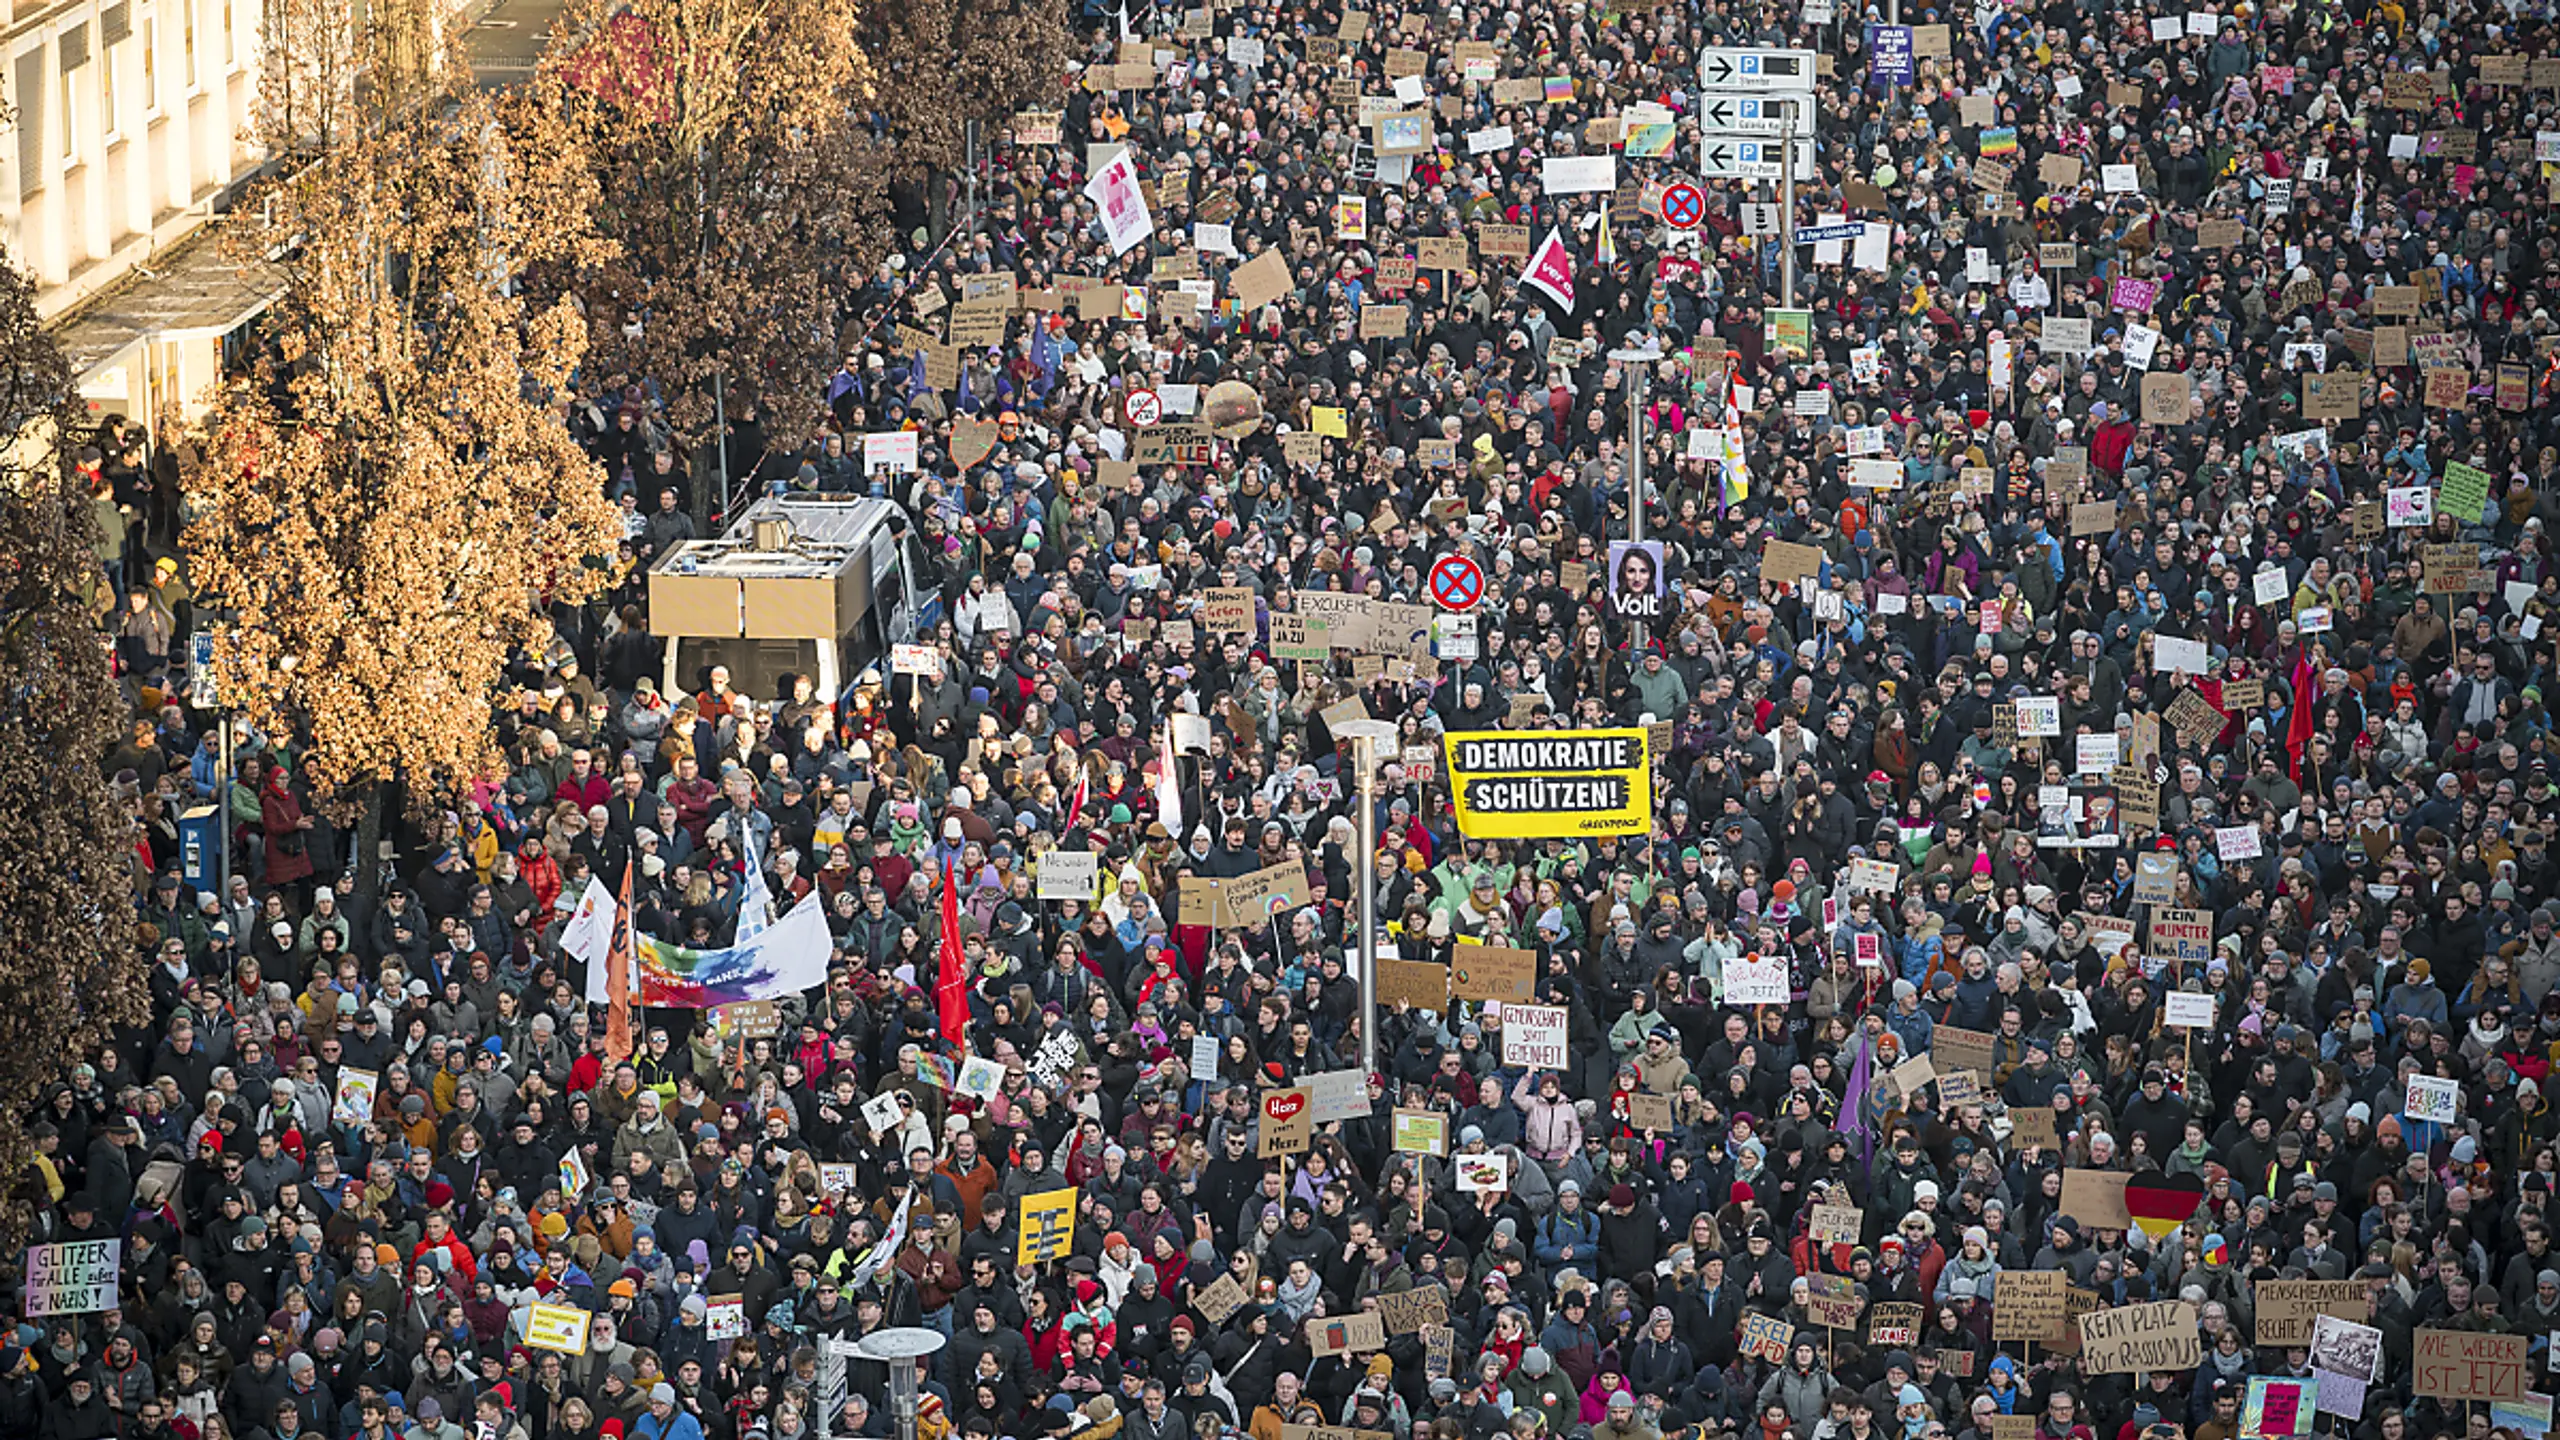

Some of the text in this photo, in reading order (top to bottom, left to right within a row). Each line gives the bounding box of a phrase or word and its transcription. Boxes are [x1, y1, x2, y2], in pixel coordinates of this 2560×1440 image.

[1743, 145, 1755, 159] P
[1738, 163, 1778, 175] City-Point
[1164, 434, 1208, 444] RECHTE
[1159, 446, 1208, 462] ALLE
[1301, 597, 1372, 615] EXCUSE ME
[1612, 593, 1661, 616] Volt
[1288, 617, 1303, 629] ZU
[1290, 630, 1305, 643] ZU
[1464, 740, 1627, 769] DEMOKRATIE
[1476, 775, 1618, 810] SCHÜTZEN!
[1578, 817, 1641, 830] GREENPEACE
[2161, 910, 2196, 923] KEIN
[1503, 1007, 1565, 1029] GEMEINSCHAFT
[1505, 1045, 1562, 1066] GEMEINHEIT
[37, 1243, 109, 1266] GLITZER
[47, 1266, 80, 1287] ALLE
[2020, 1274, 2052, 1286] Protest
[48, 1290, 88, 1311] NAZIS
[1384, 1288, 1438, 1310] NAZIS
[2259, 1284, 2368, 1302] MENSCHENRECHTE
[2291, 1302, 2331, 1314] STATT
[1748, 1316, 1790, 1345] EKEL
[2085, 1301, 2177, 1341] KEIN PLATZ
[2258, 1320, 2299, 1341] RECHTE
[1742, 1334, 1785, 1362] HAFD
[2119, 1334, 2200, 1369] RASSISMUS
[2419, 1336, 2518, 1360] NIE WIEDER
[2418, 1362, 2521, 1397] IST JETZT
